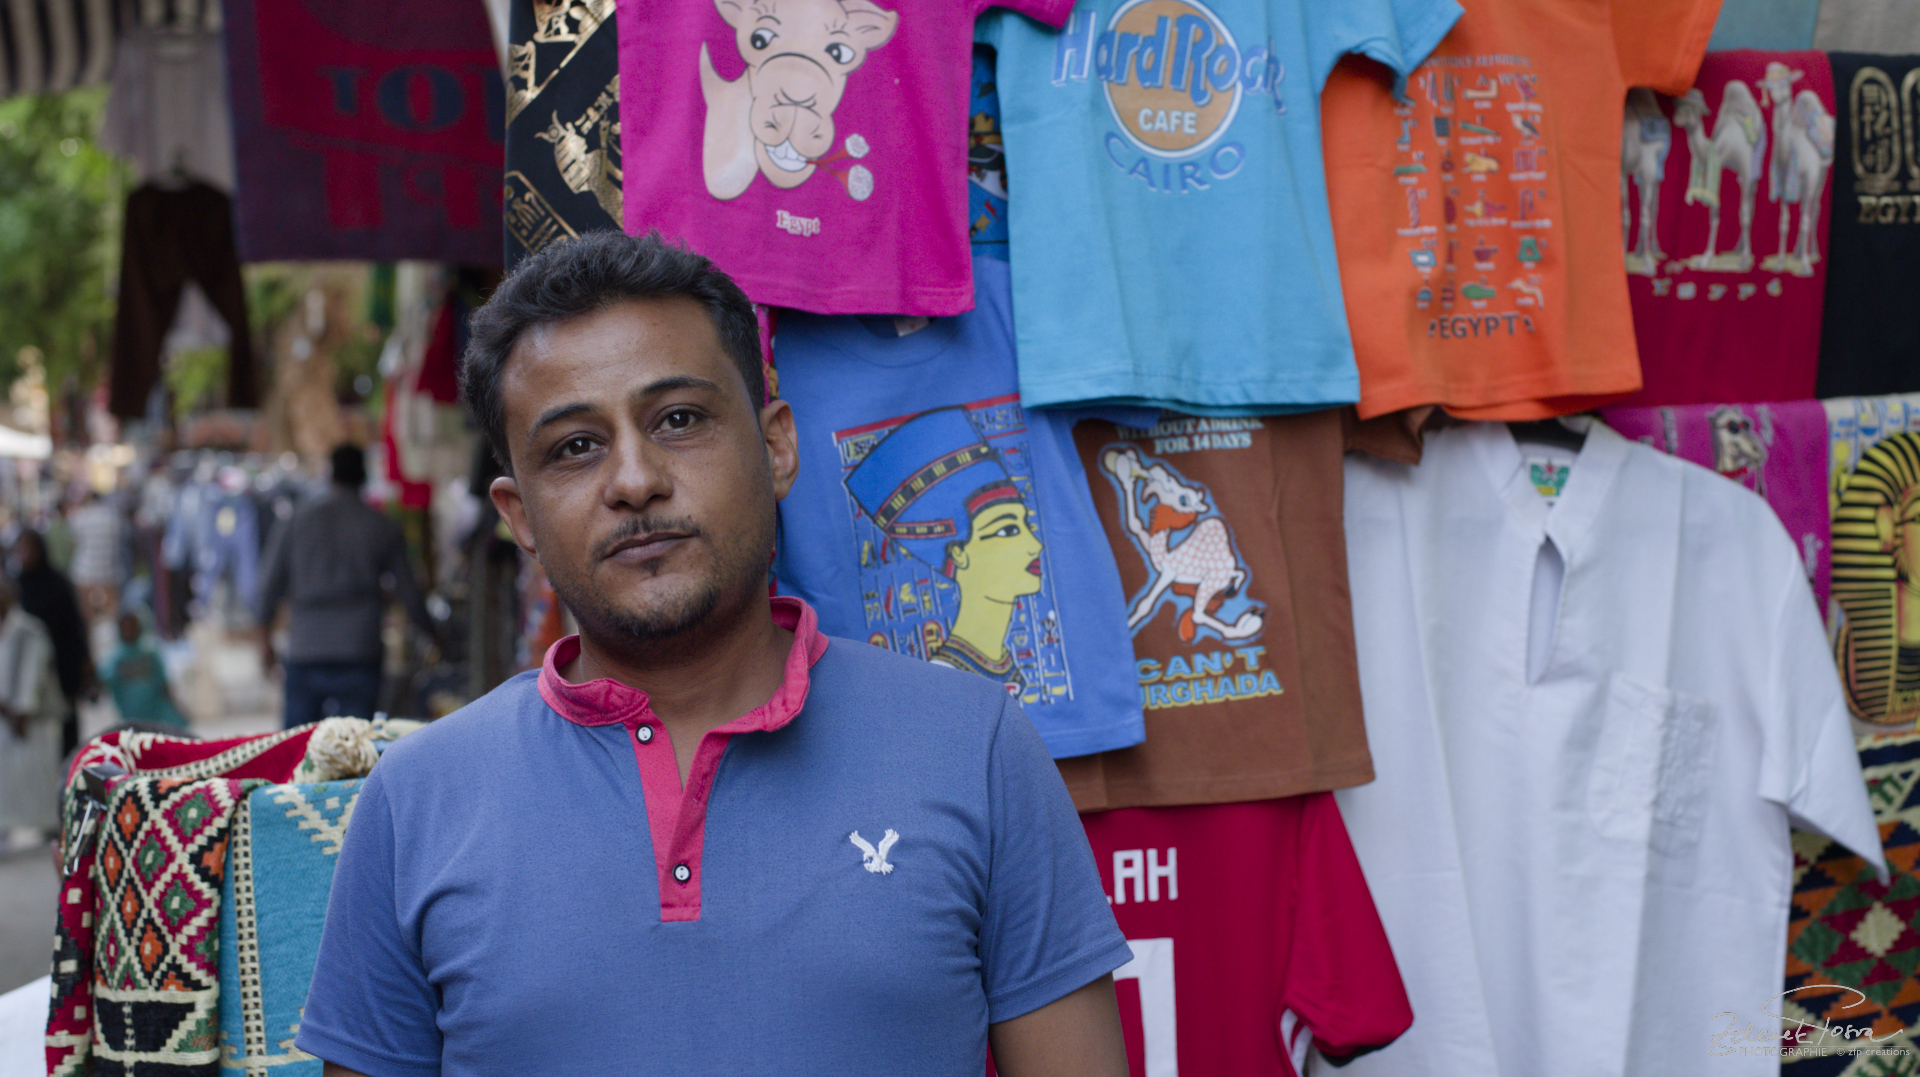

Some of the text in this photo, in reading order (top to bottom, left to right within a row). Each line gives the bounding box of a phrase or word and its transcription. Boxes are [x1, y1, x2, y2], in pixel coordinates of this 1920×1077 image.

[1051, 9, 1287, 115] Hard Rock
[1137, 107, 1198, 135] CAFE
[1104, 131, 1245, 194] CAIRO
[776, 209, 821, 237] Egypt
[1154, 431, 1253, 455] FOR 14 DAYS
[1106, 847, 1179, 905] AH
